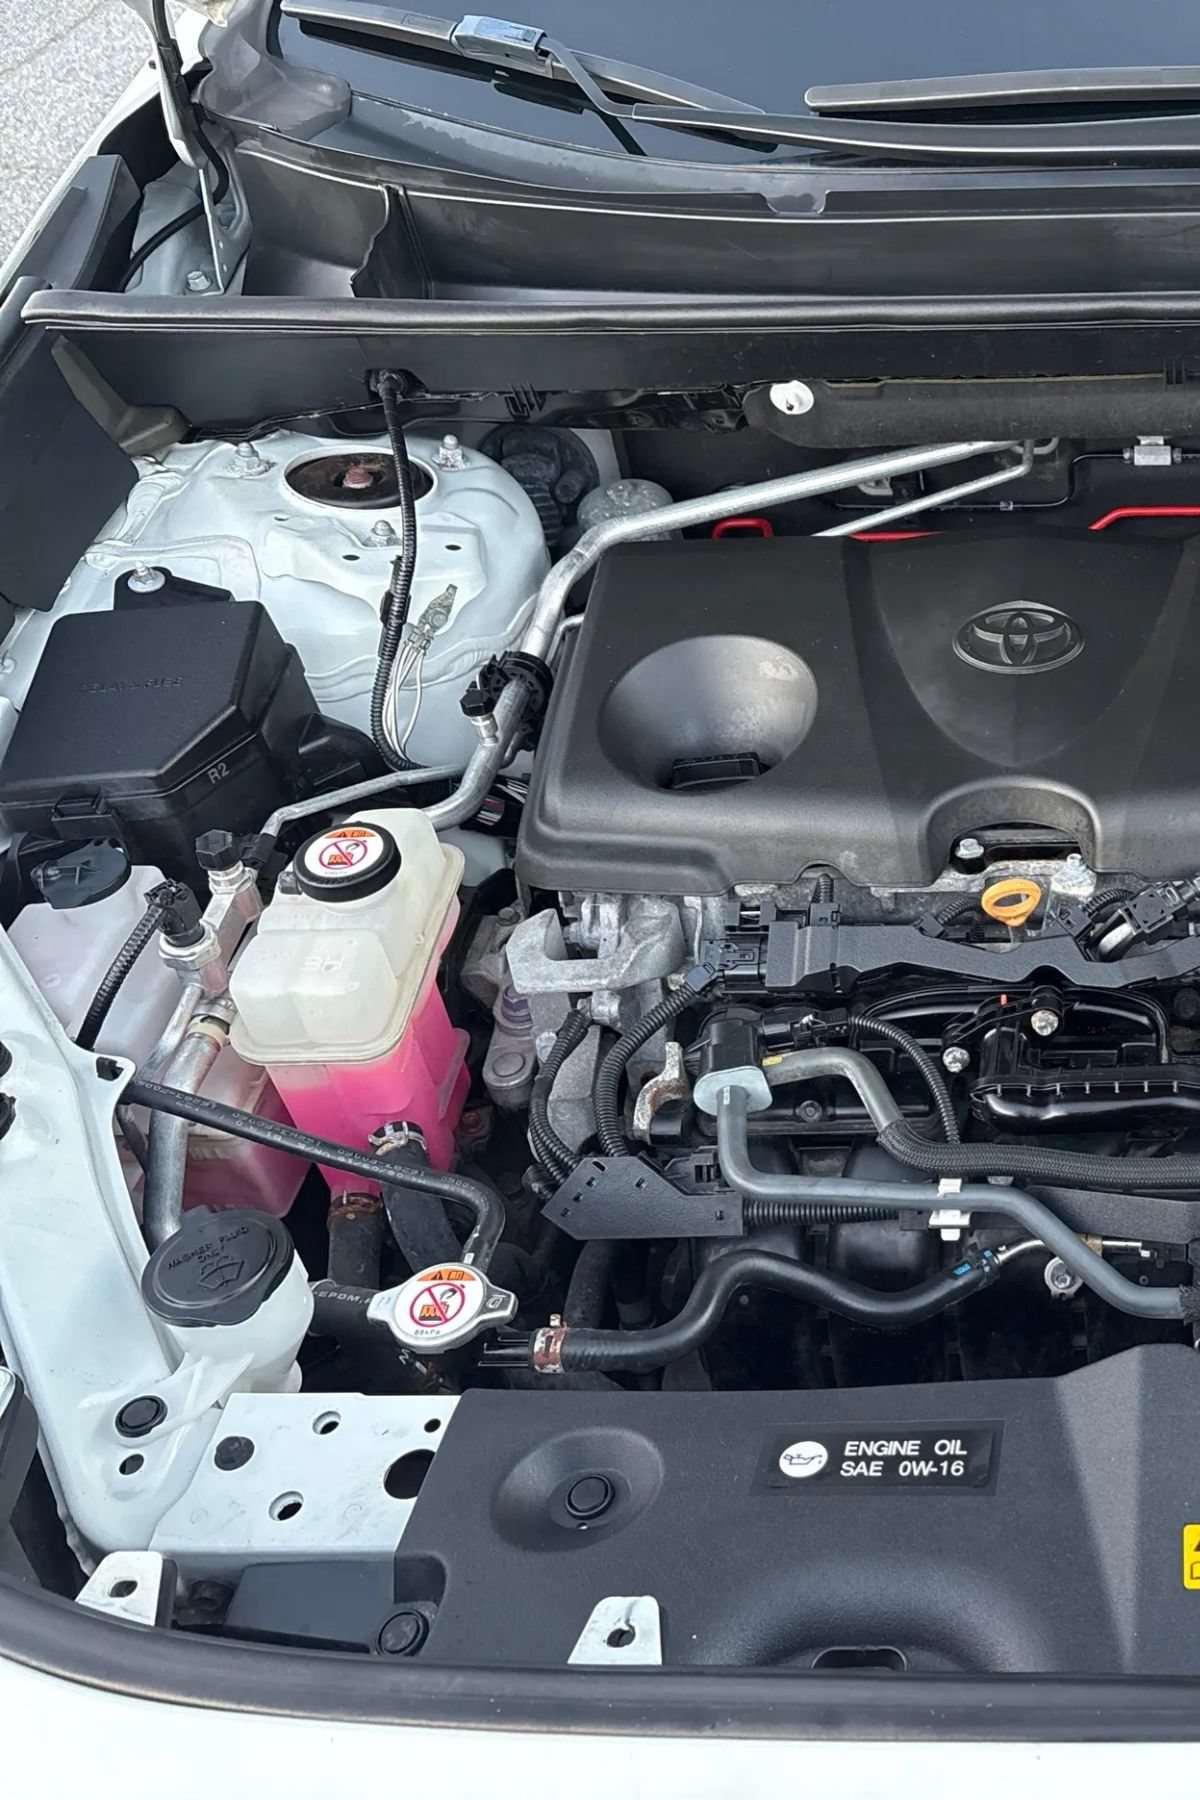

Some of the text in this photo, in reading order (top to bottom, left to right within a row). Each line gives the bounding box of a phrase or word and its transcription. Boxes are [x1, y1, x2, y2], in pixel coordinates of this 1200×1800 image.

[207, 762, 230, 784] R2
[844, 1439, 968, 1457] ENGINE OIL
[840, 1460, 965, 1477] SAE 0W-16
